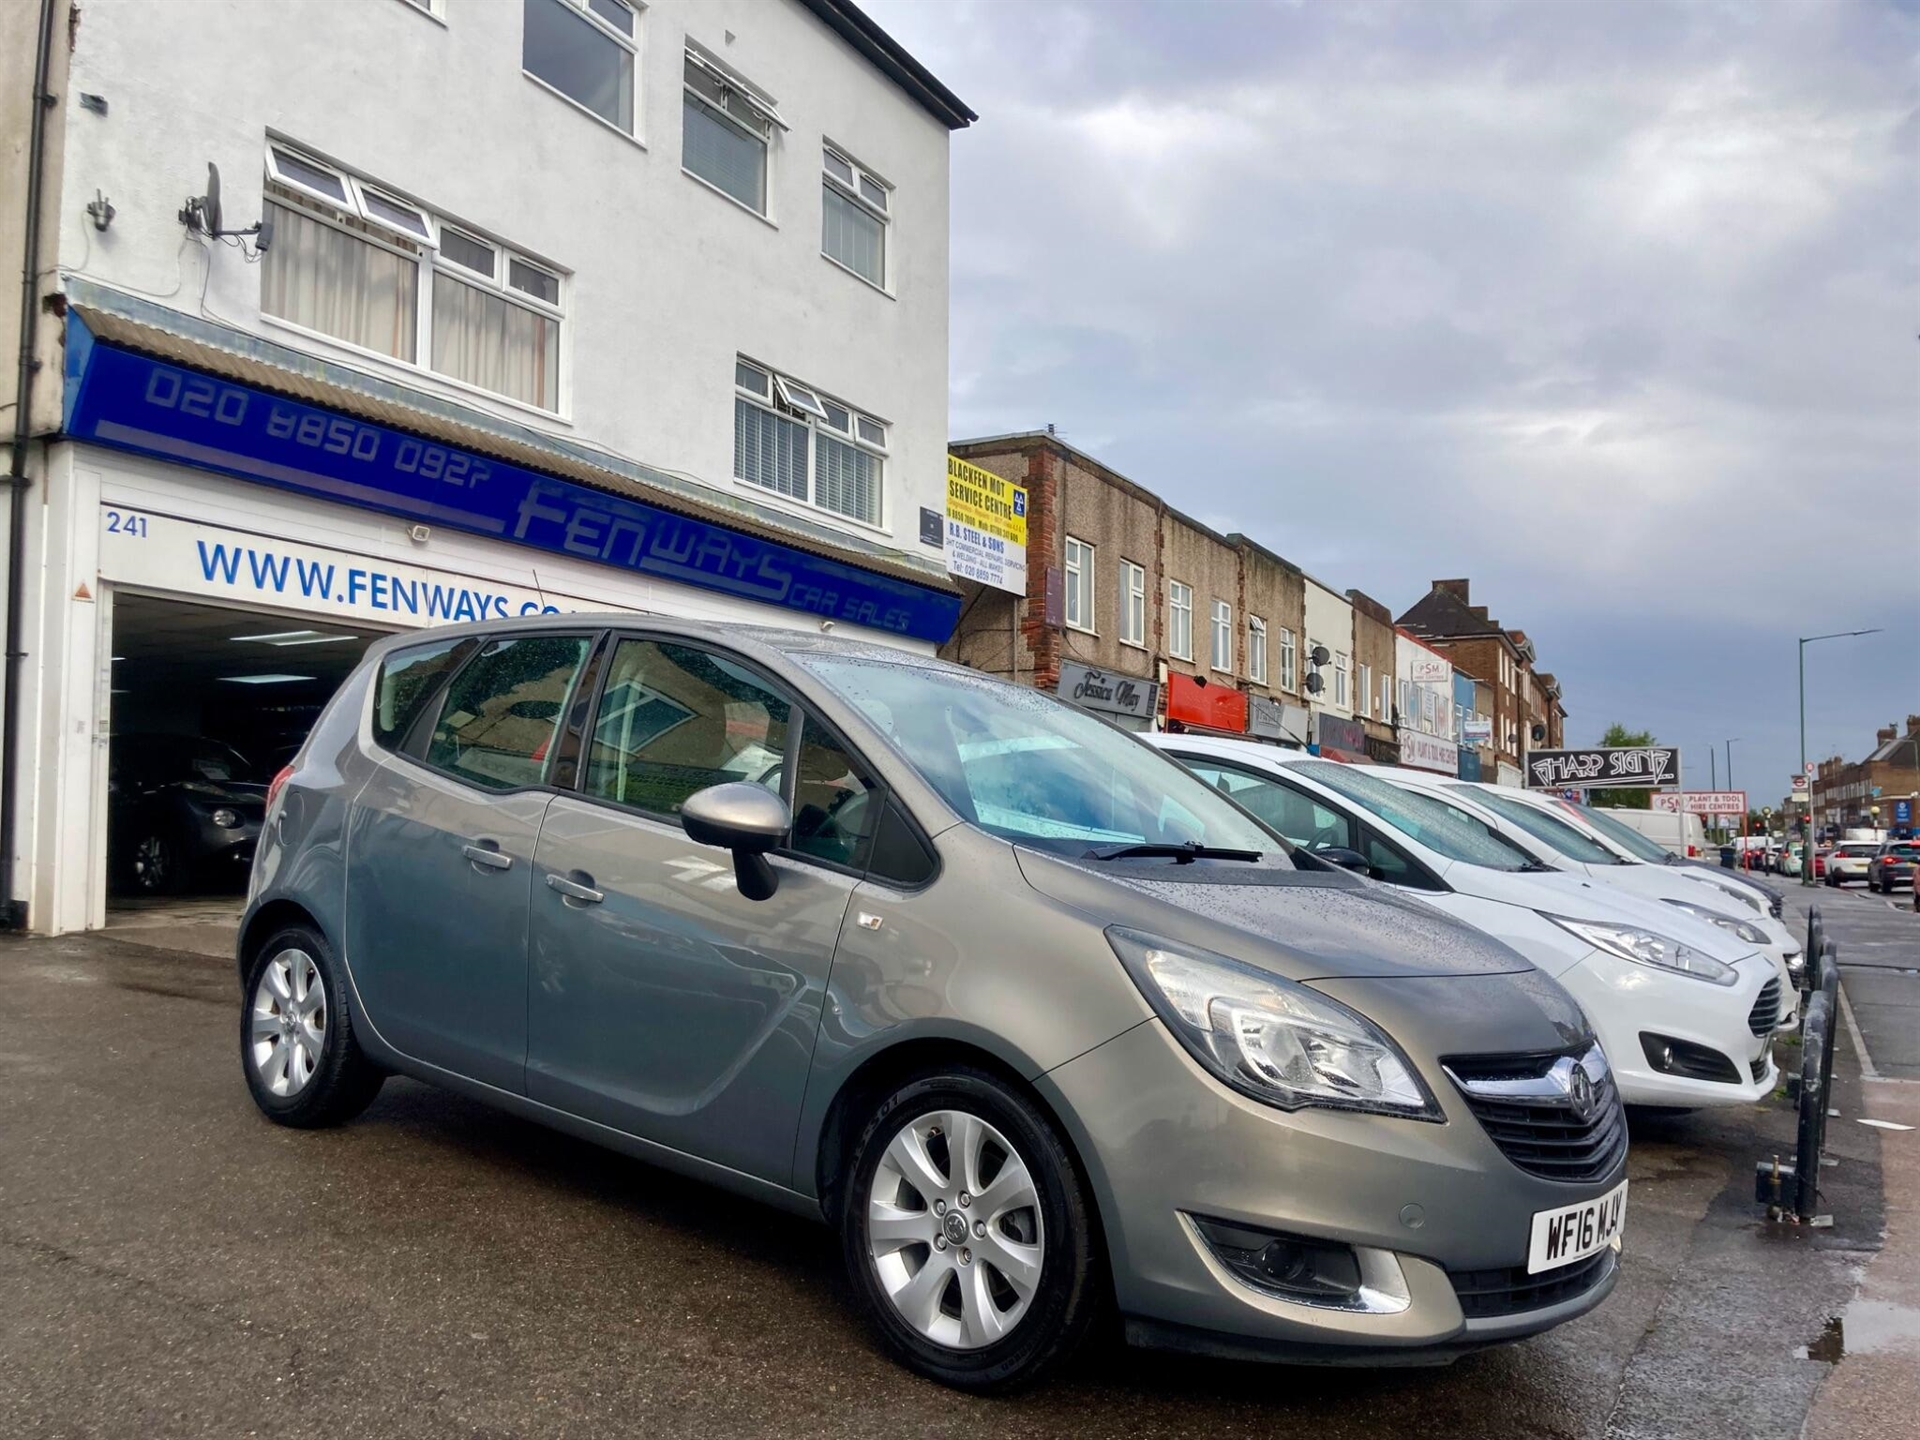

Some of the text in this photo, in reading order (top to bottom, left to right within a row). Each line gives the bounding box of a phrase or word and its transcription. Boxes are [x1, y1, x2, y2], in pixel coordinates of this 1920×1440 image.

[145, 368, 249, 426] 020
[947, 457, 1004, 498] BLACKFEN MOT
[949, 479, 982, 508] SERVICE
[984, 494, 1011, 520] CENTRE
[106, 511, 147, 539] 241
[949, 522, 961, 538] R.B.
[963, 527, 980, 545] STEEL
[982, 534, 986, 547] &
[988, 536, 1004, 554] SONS
[953, 560, 963, 572] Tel:
[788, 582, 841, 614] CAR
[842, 596, 911, 632] SALES
[1419, 663, 1439, 674] PSM
[1531, 750, 1672, 786] SHARP SIGNS
[1547, 1190, 1622, 1261] WF16 MJY
